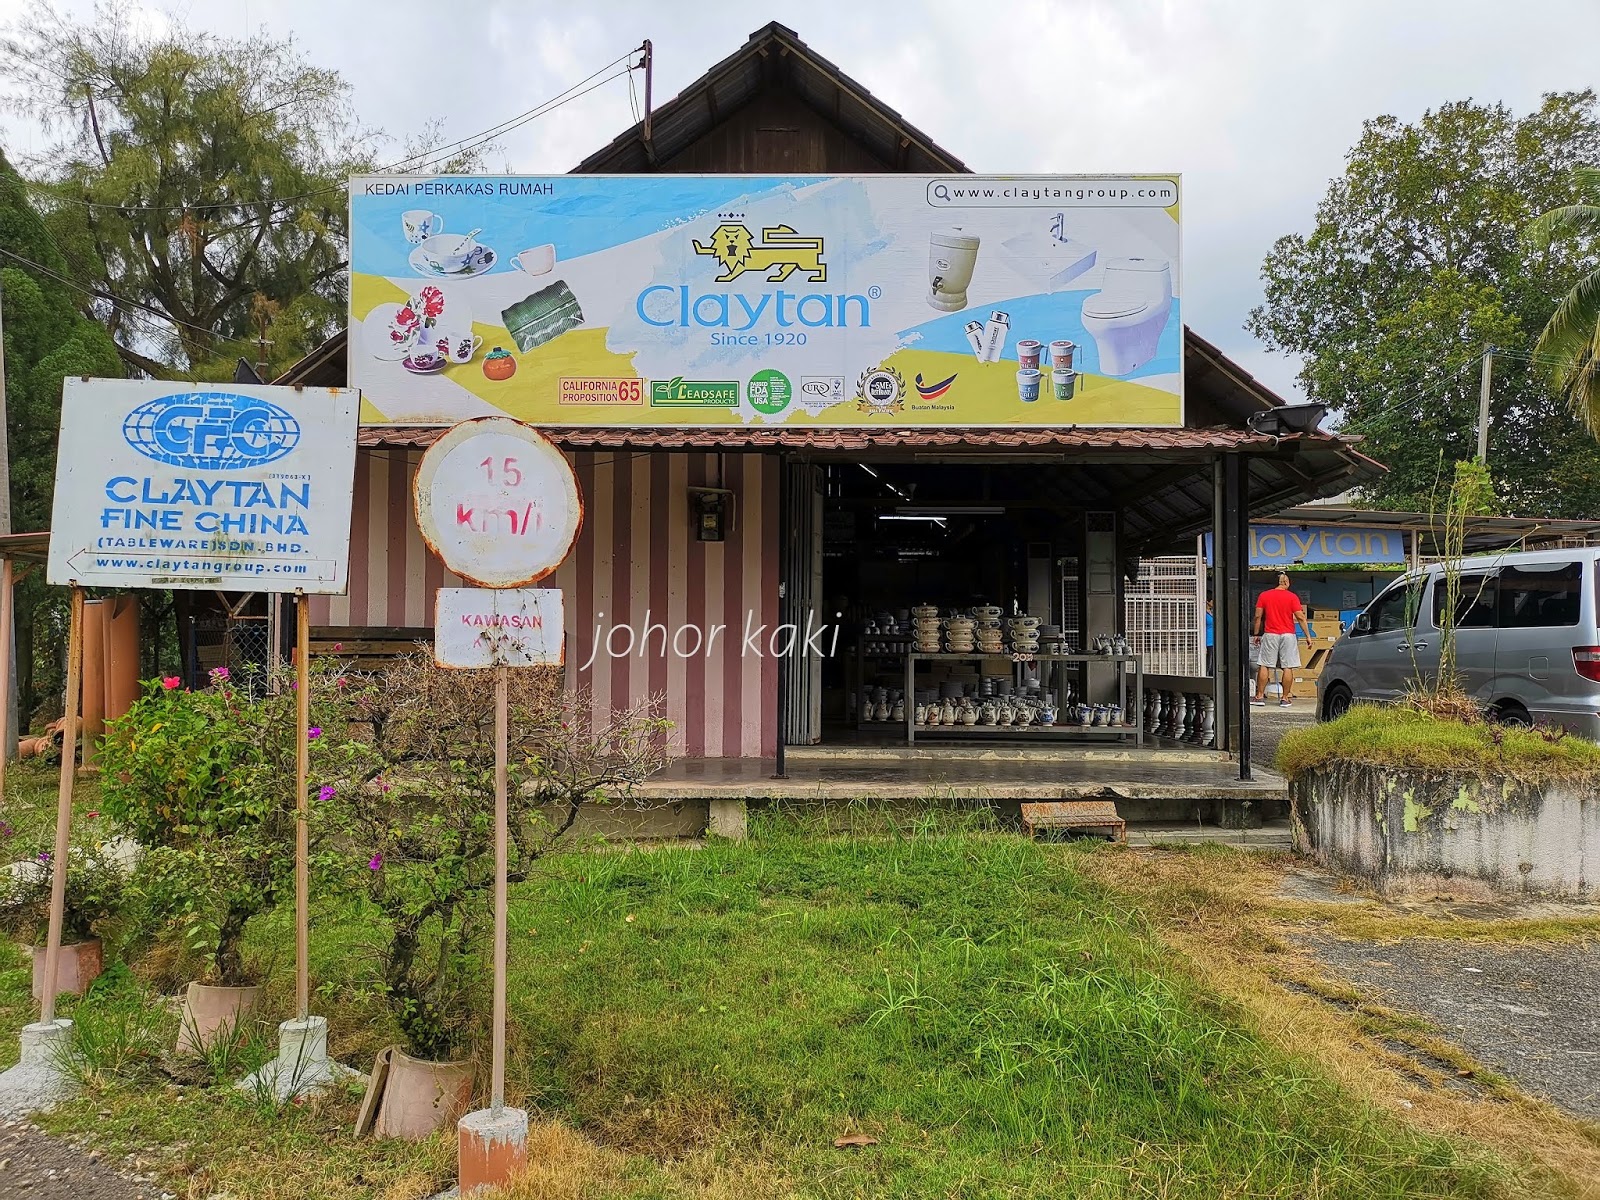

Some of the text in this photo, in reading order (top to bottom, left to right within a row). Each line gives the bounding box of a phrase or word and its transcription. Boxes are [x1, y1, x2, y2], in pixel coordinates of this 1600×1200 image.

[365, 183, 553, 195] KEDAI PERKAKAS RUMAH
[953, 187, 1171, 199] www.claytangroup.com
[710, 332, 807, 346] Since 1920
[562, 381, 641, 402] CALIFORNIA 65
[677, 384, 735, 399] LEADSAFE
[750, 386, 768, 395] FDA
[807, 384, 826, 395] URS
[562, 393, 618, 402] PROPOSITION
[754, 397, 768, 405] USA
[480, 456, 522, 487] 15
[105, 476, 310, 510] CLAYTAN
[100, 508, 310, 536] FINE CHINA
[456, 502, 543, 536] km/
[1249, 529, 1389, 560] laytan
[96, 558, 307, 574] www.claytangroup.com
[461, 614, 543, 629] KAWASAN
